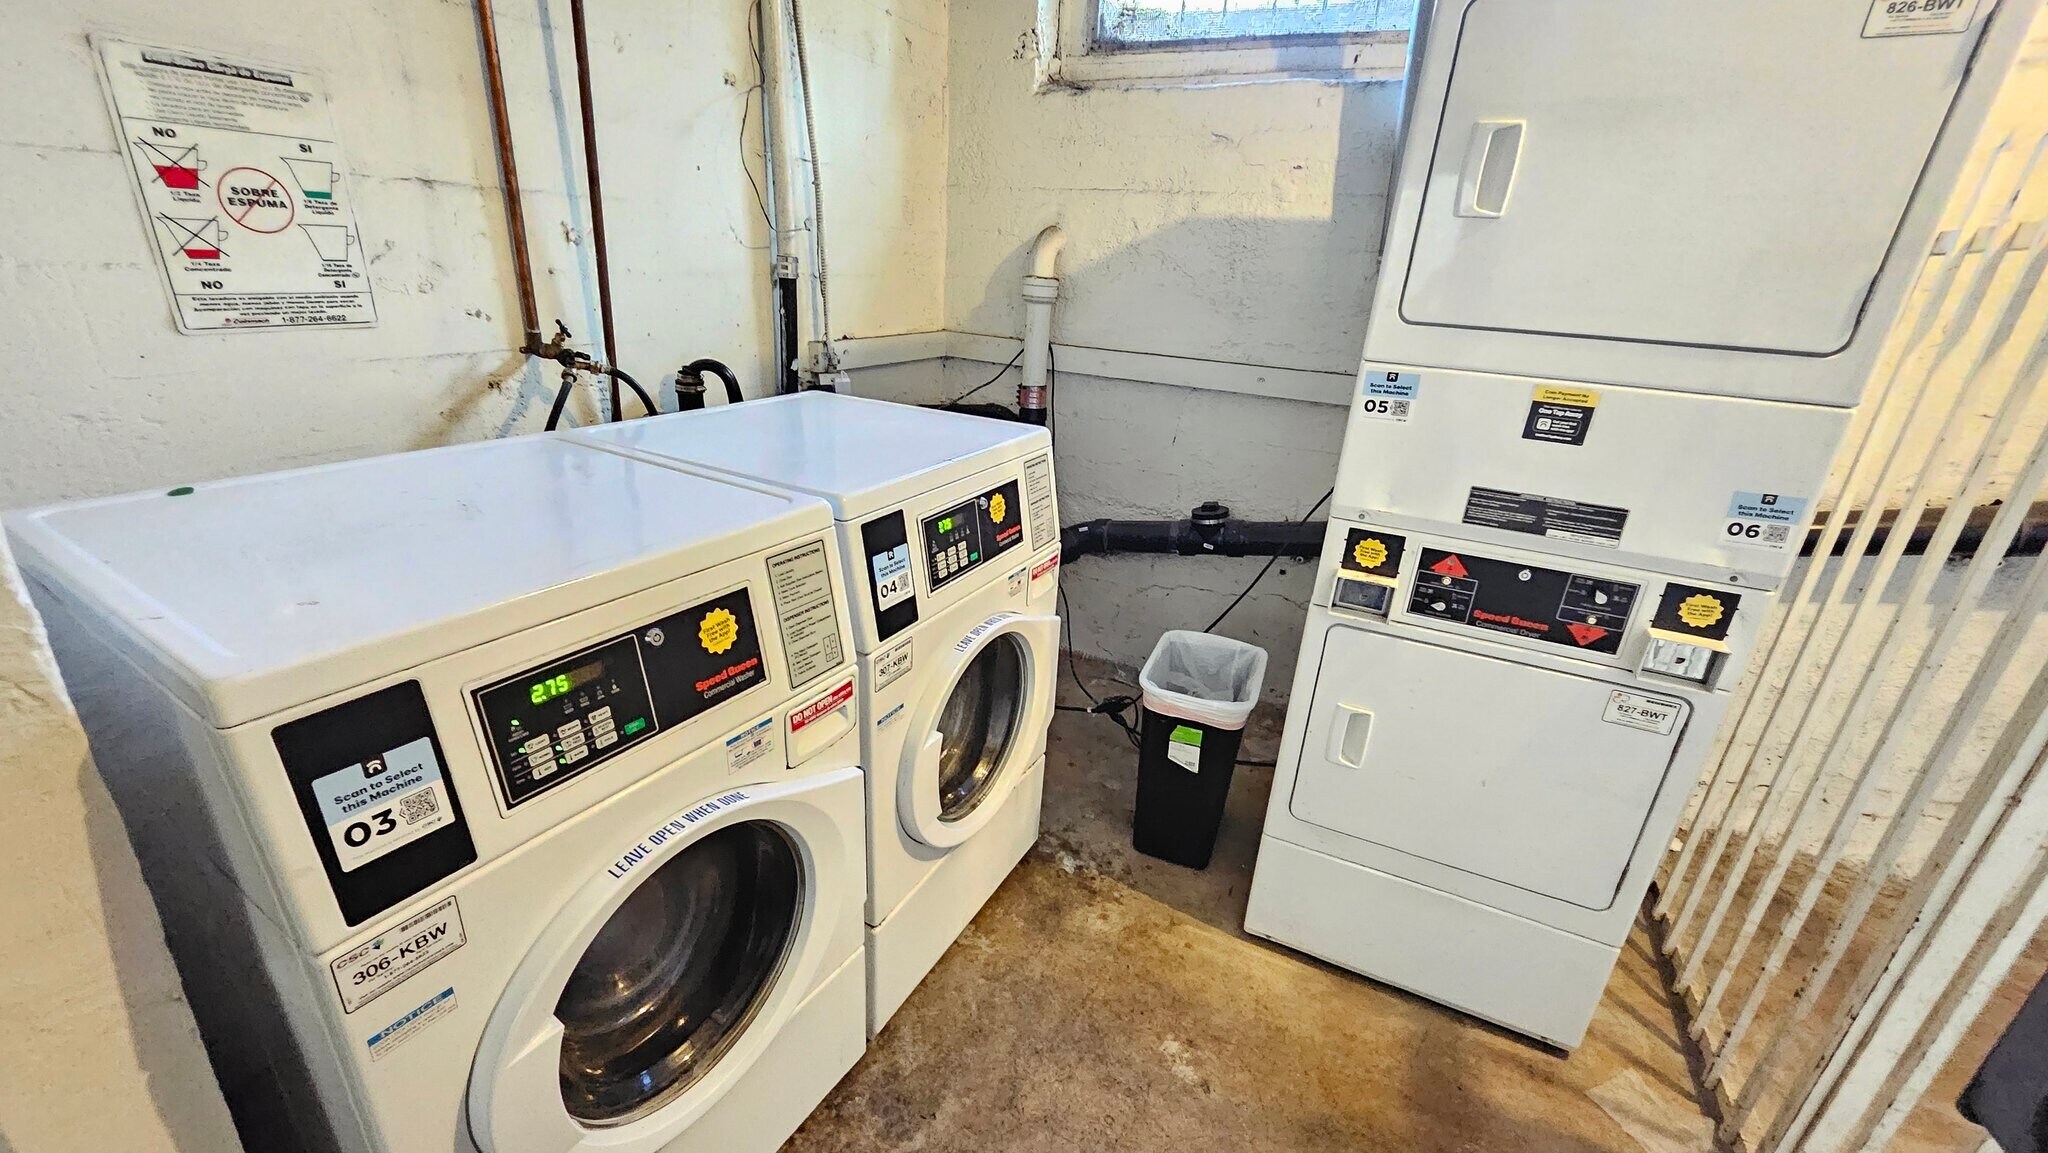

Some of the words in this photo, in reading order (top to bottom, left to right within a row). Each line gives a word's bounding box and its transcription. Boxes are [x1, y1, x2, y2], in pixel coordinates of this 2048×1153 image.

[152, 126, 177, 138] NO
[299, 143, 313, 154] SI
[230, 186, 280, 198] SOBRE
[227, 197, 288, 209] ESPUMA
[200, 280, 224, 290] NO
[334, 280, 347, 288] SI
[1364, 400, 1389, 414] 05
[1754, 512, 1790, 520] Machine
[1768, 508, 1794, 516] Select
[1727, 522, 1762, 538] 06
[772, 556, 794, 568] OPERATING
[888, 564, 906, 574] Machine
[880, 580, 898, 598] 04
[716, 617, 731, 628] Wash
[1473, 609, 1510, 624] Speed
[1510, 616, 1549, 632] Queen
[706, 630, 716, 638] Free
[717, 622, 730, 633] with
[1476, 620, 1519, 634] Commercial
[1520, 628, 1542, 639] Dryer
[695, 670, 728, 692] Speed
[728, 658, 758, 676] Queen
[531, 674, 568, 704] 2.75
[704, 677, 736, 699] Commercial
[736, 670, 755, 684] Washer
[792, 712, 803, 724] DO
[803, 704, 816, 718] NOT
[816, 694, 832, 710] OPEN
[1616, 704, 1668, 720] 827-BWT
[334, 786, 368, 806] Scan
[370, 780, 383, 791] to
[384, 762, 424, 784] Select
[341, 800, 368, 814] this
[369, 774, 423, 803] Machine
[344, 808, 398, 848] 03
[607, 842, 652, 879] LEAVE
[648, 820, 686, 846] OPEN
[682, 801, 721, 823] WHEN
[717, 791, 751, 806] DONE
[336, 946, 370, 970] CSC
[352, 922, 447, 986] 306-KBW
